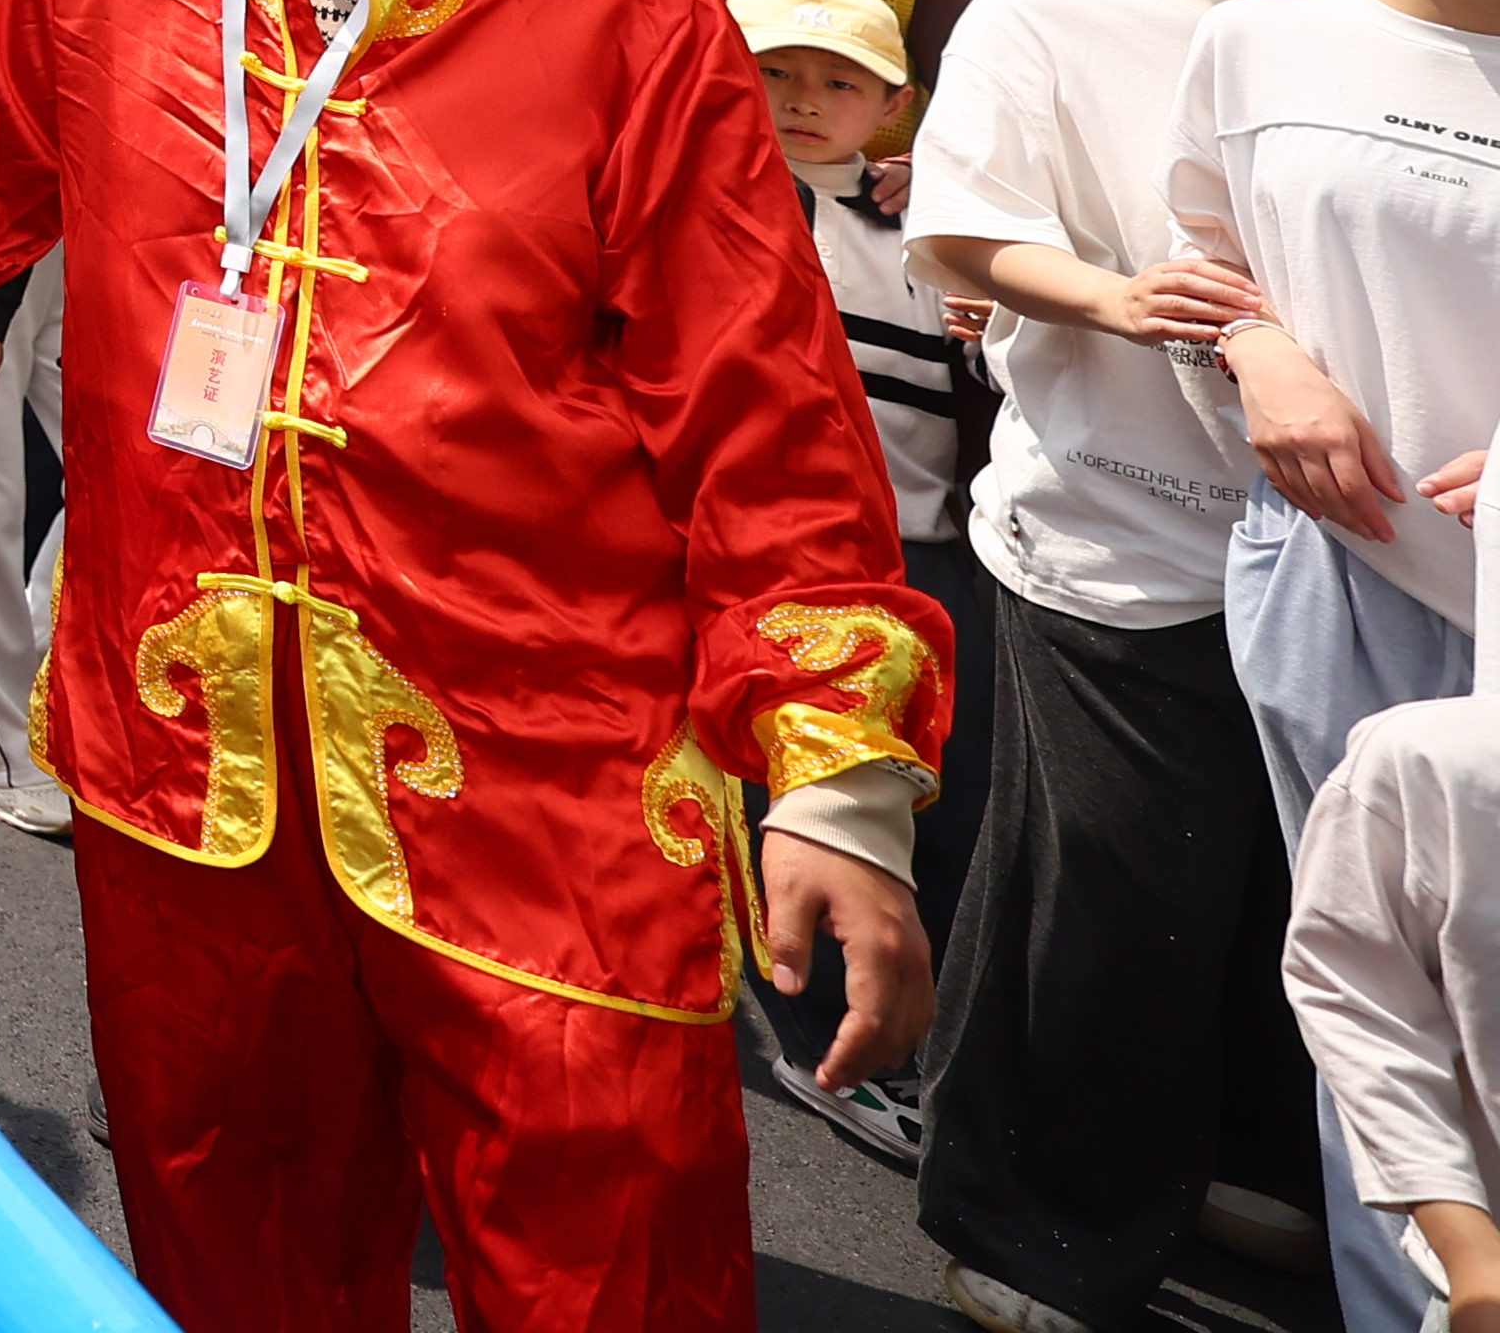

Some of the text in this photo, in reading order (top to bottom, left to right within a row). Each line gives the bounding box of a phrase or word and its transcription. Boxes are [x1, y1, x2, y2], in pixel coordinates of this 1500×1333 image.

[1384, 114, 1447, 135] OLNY
[203, 347, 228, 403] 演艺证
[1066, 449, 1202, 496] L'ORIGINALE
